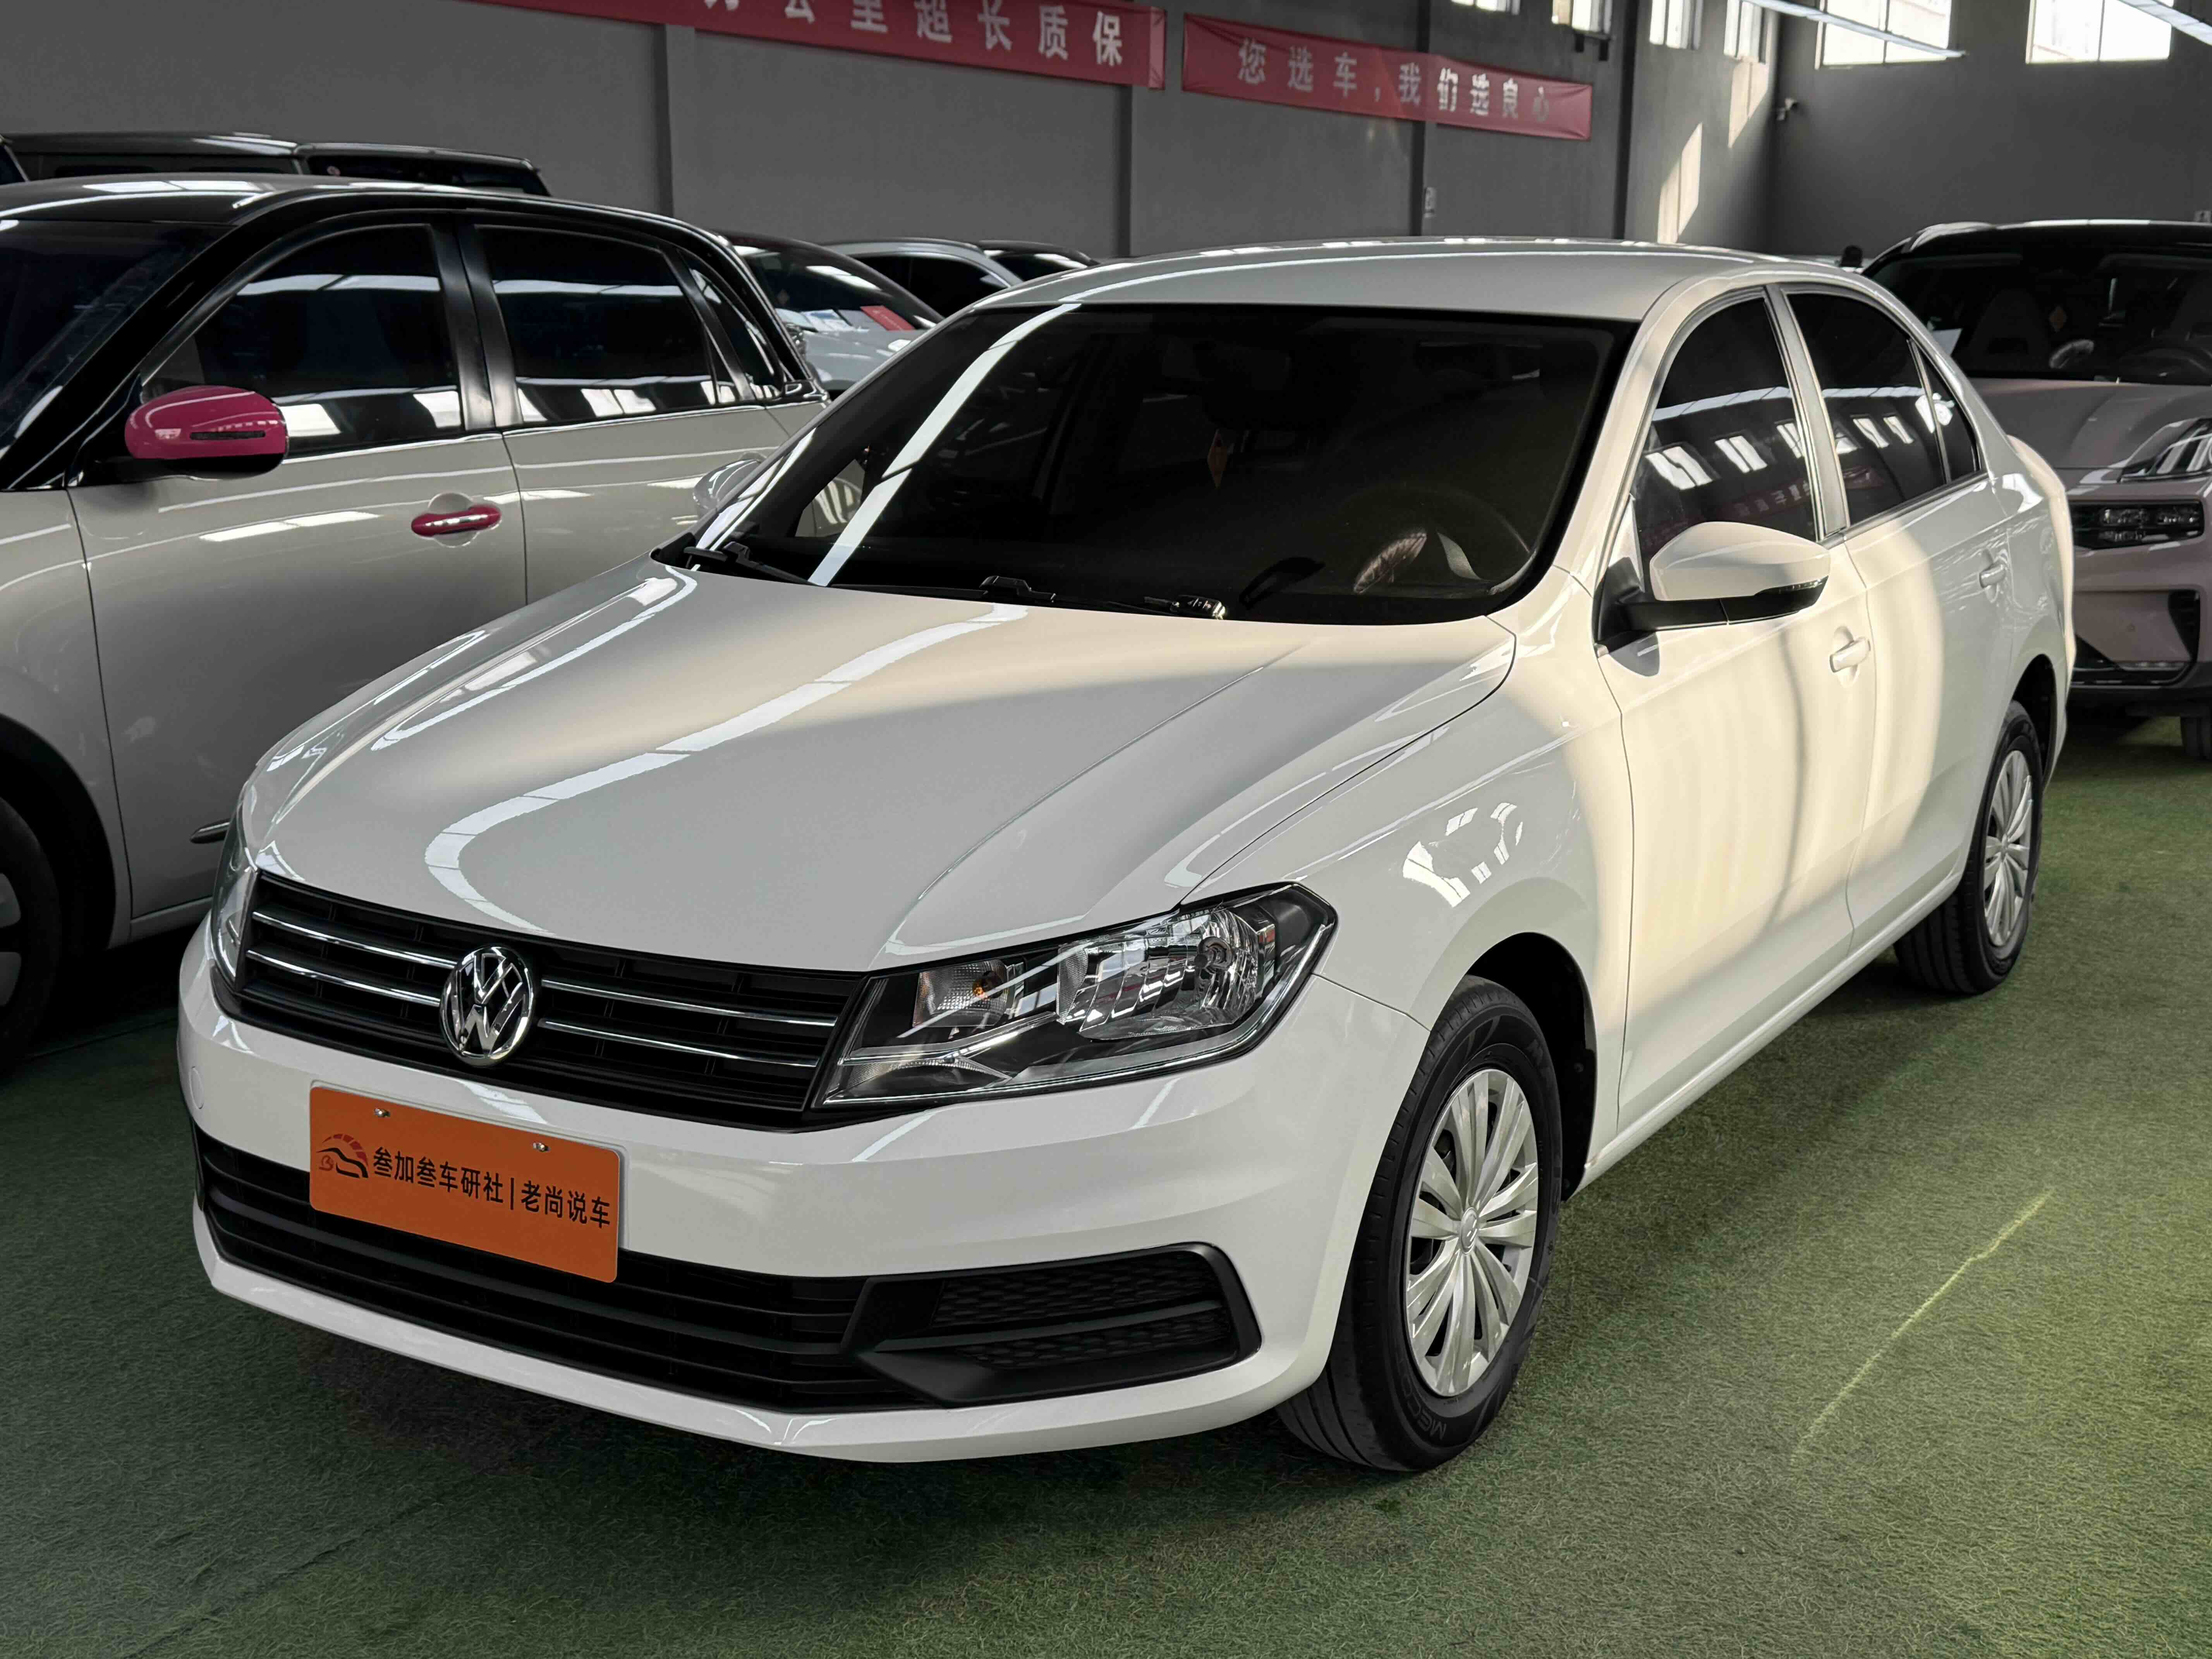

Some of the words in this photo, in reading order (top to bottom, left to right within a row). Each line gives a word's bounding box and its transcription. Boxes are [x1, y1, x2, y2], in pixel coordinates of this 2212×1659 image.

[704, 0, 1122, 66] 里超长质保
